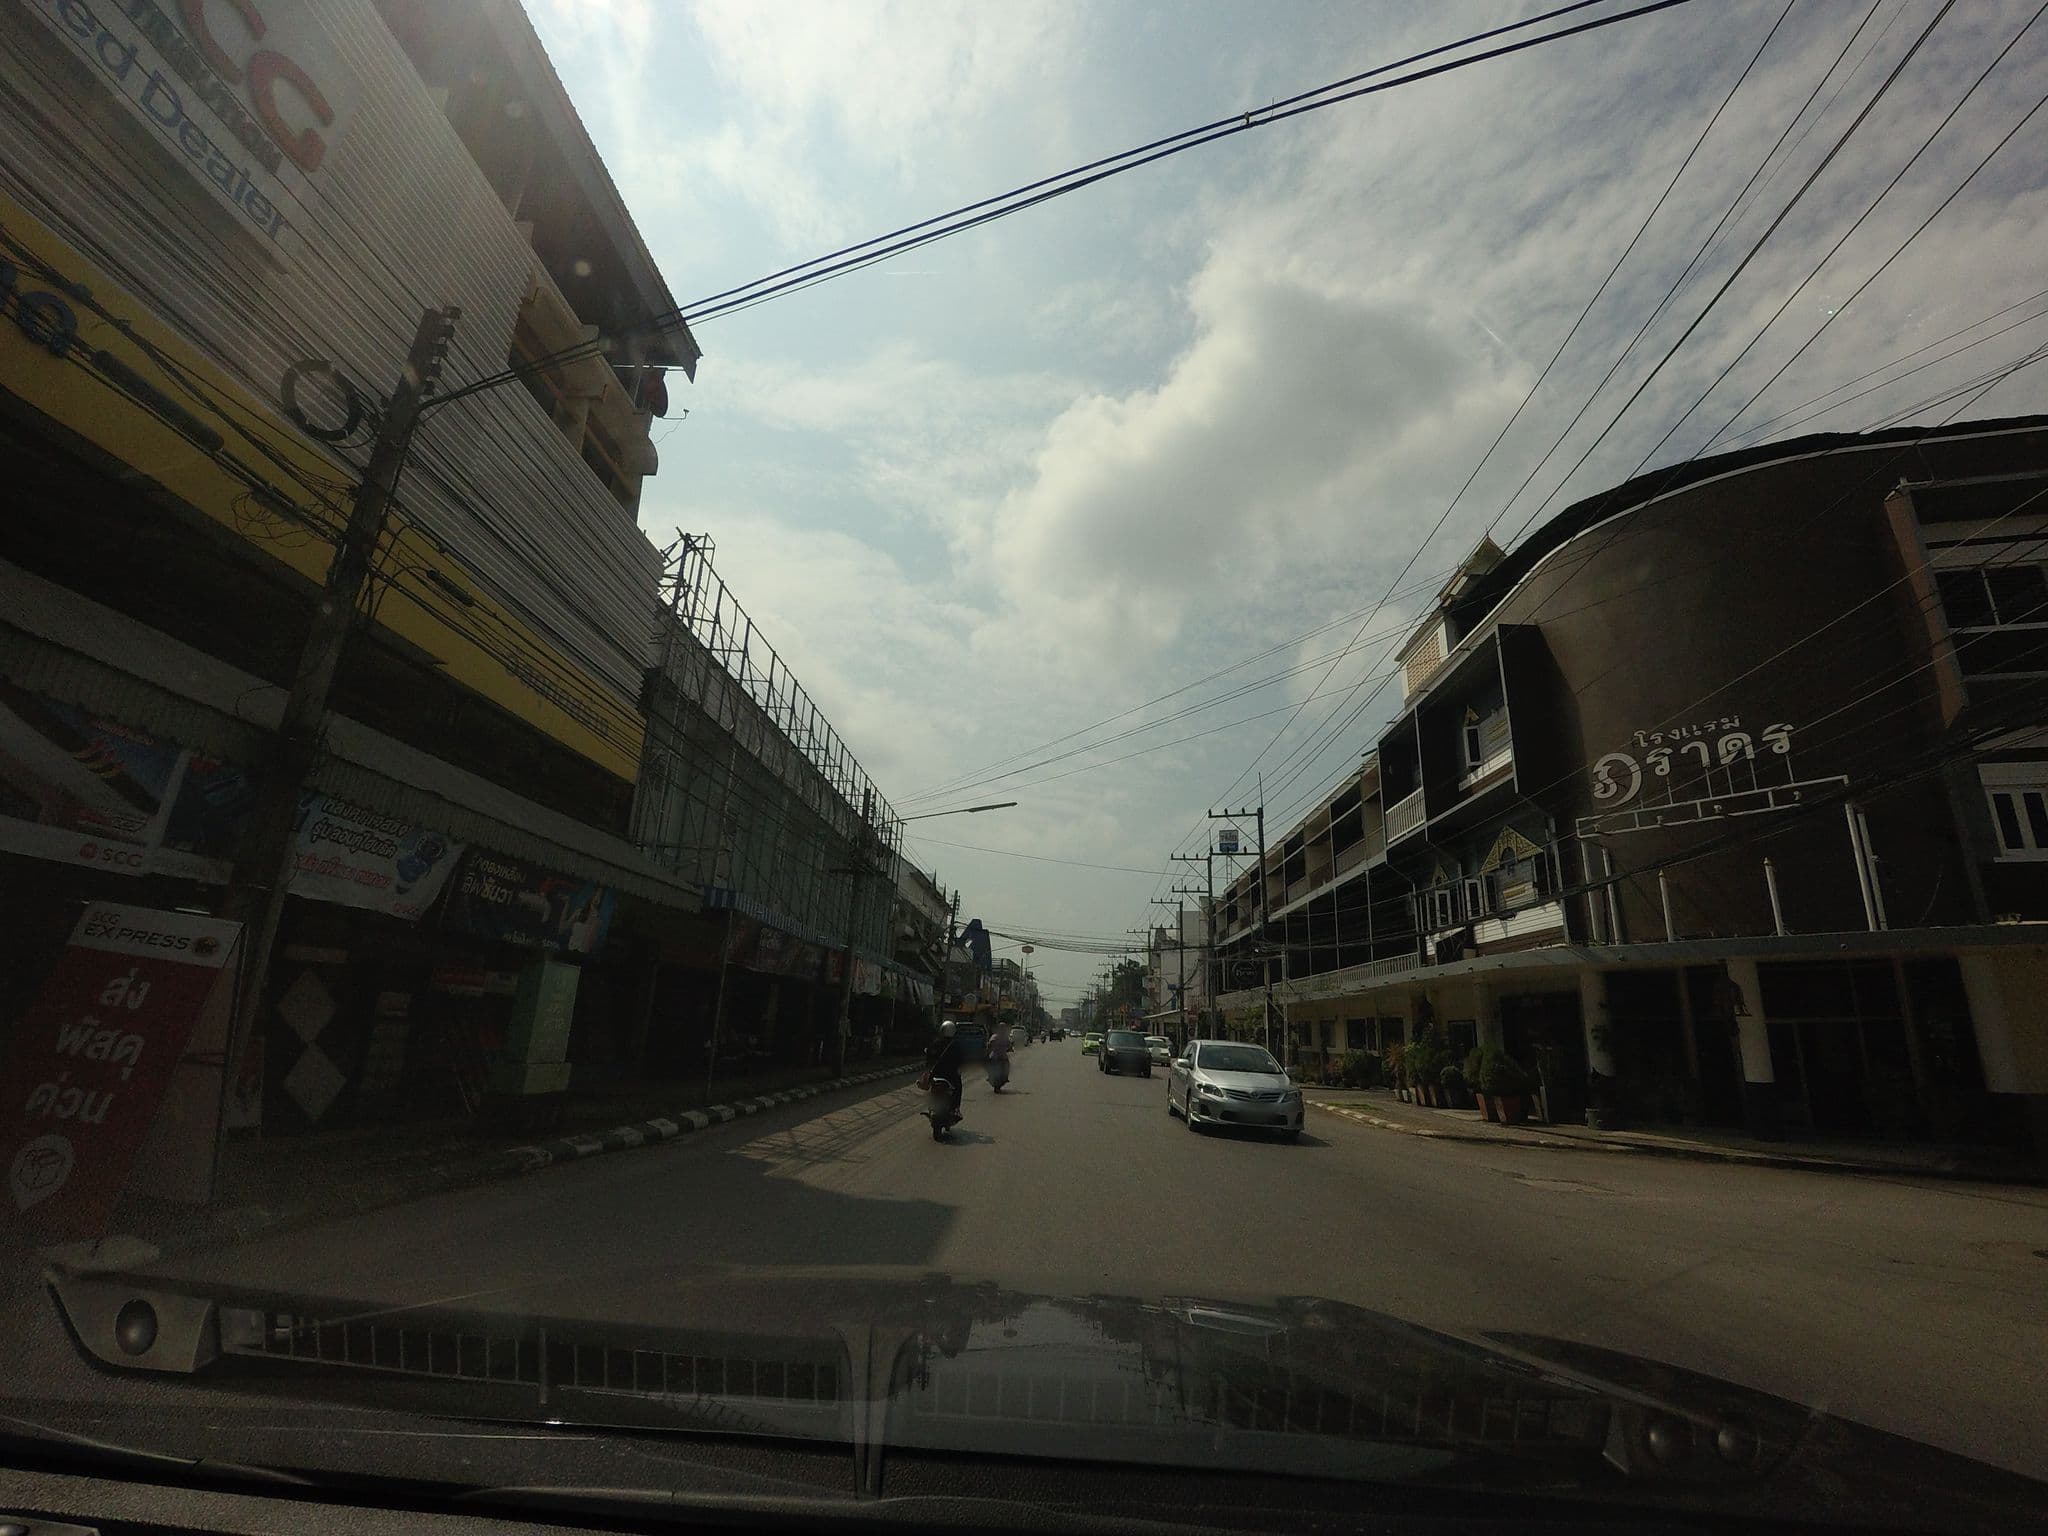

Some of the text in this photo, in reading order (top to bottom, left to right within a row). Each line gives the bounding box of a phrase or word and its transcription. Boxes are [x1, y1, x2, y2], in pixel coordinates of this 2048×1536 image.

[55, 0, 290, 240] ed Dealer
[1633, 716, 1742, 748] โรงแรม
[84, 922, 192, 951] EXPRESS
[98, 967, 152, 1010] ส่ง
[55, 1015, 146, 1081] พัสดุ
[24, 1071, 115, 1124] ด่วน
